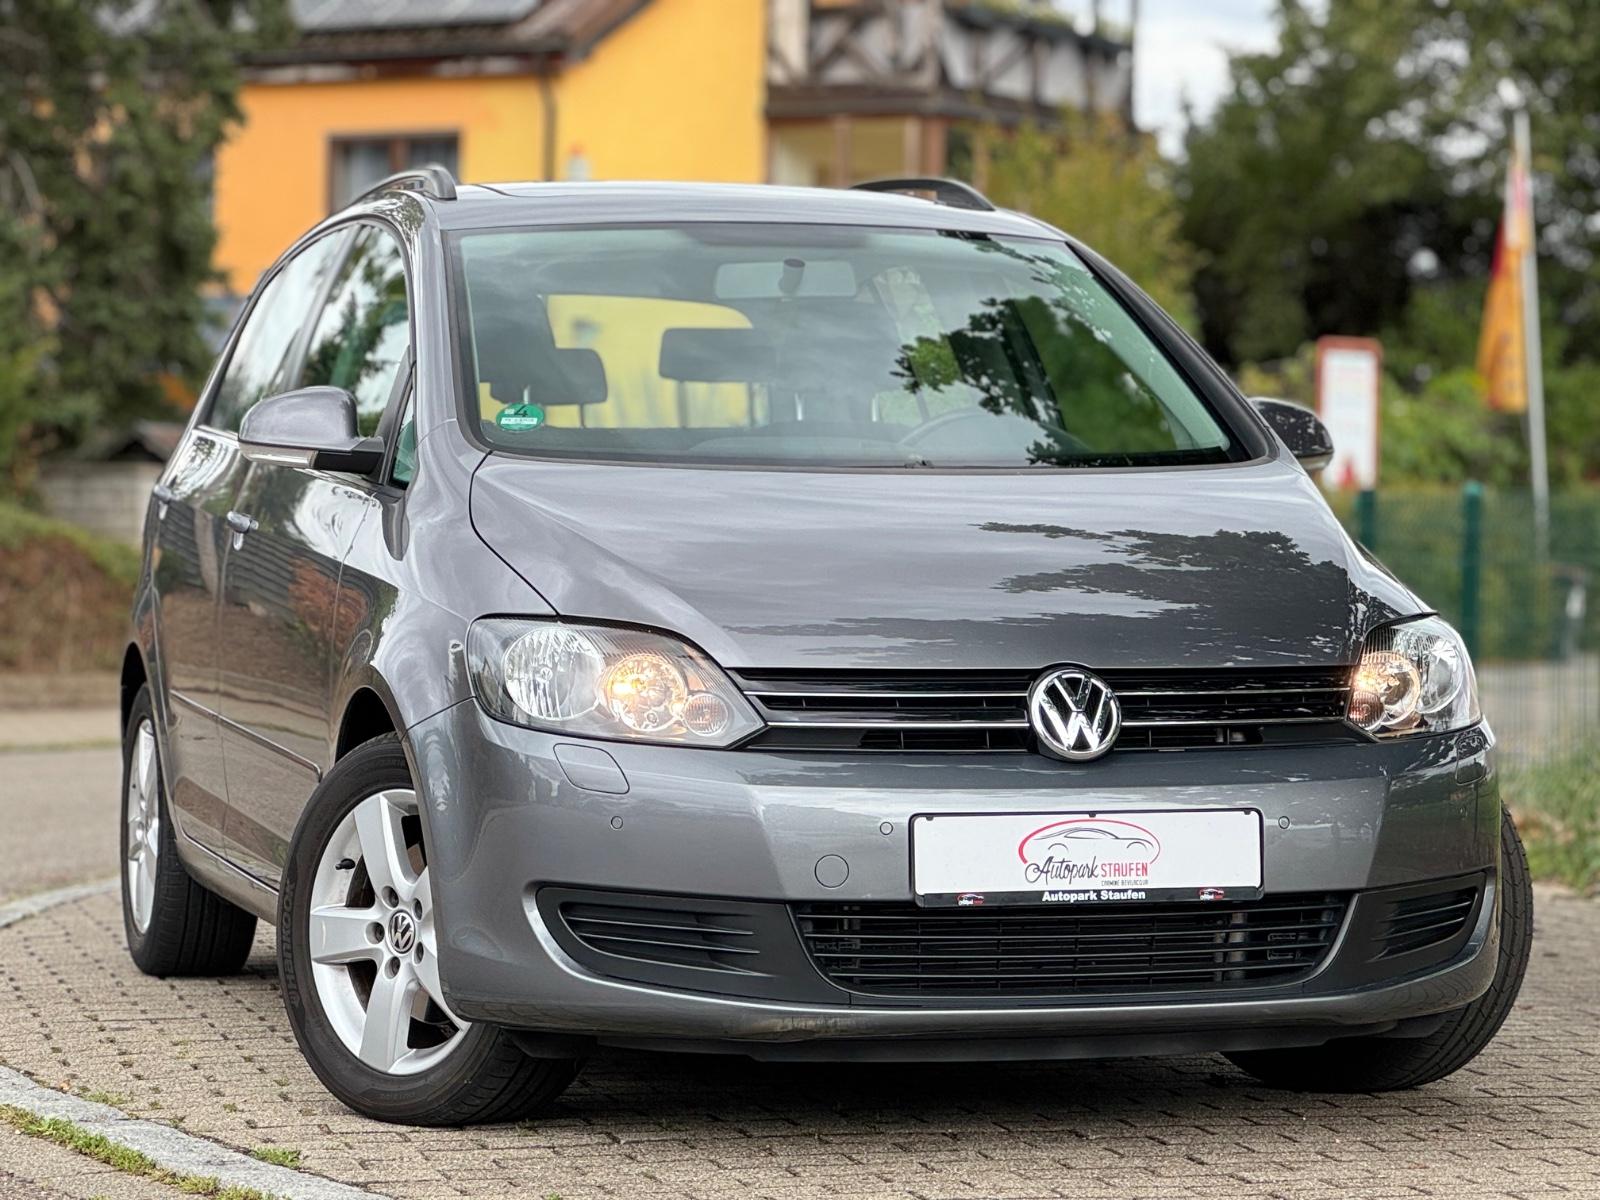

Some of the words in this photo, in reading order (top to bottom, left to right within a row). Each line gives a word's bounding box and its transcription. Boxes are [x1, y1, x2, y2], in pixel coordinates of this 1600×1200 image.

[514, 405, 528, 417] 4
[1025, 855, 1099, 885] Autopark
[1100, 862, 1148, 878] STAUFEN
[1042, 890, 1098, 903] Autopark
[1100, 889, 1146, 900] Staufen
